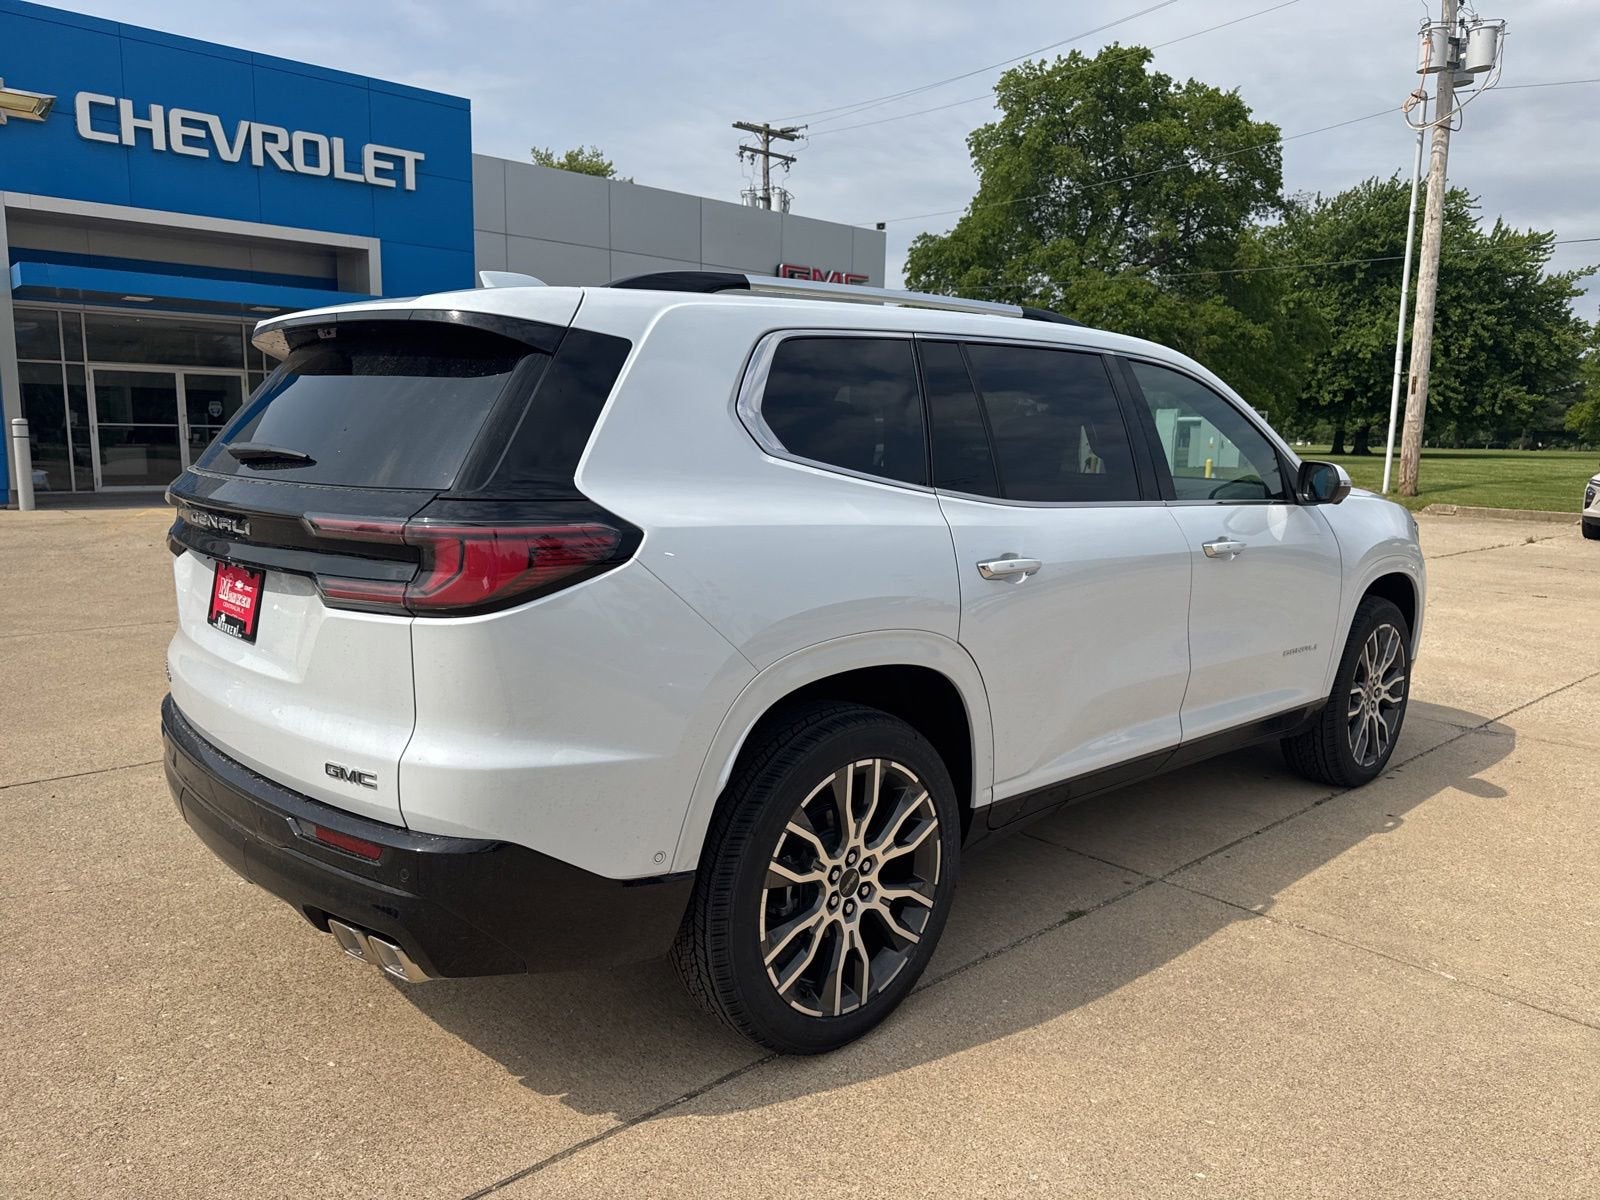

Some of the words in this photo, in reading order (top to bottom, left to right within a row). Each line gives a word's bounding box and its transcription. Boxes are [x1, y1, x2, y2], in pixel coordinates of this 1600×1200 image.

[76, 91, 425, 191] CHEVROLET
[190, 511, 250, 536] DENALI
[325, 763, 377, 789] GMC
